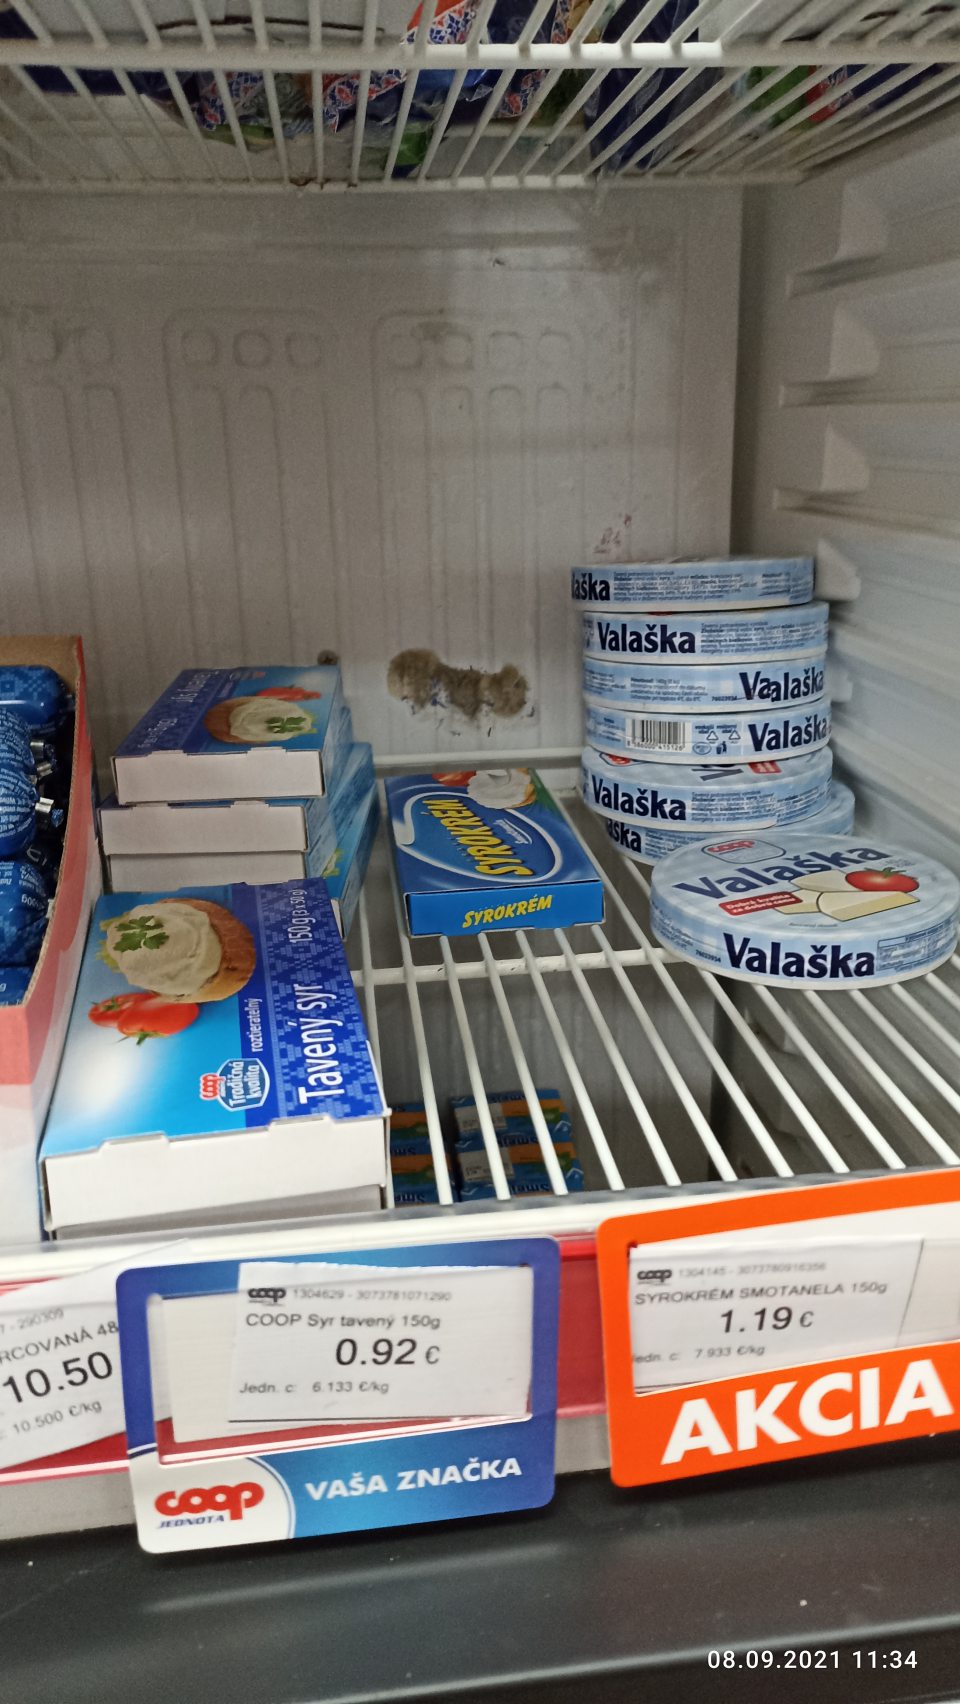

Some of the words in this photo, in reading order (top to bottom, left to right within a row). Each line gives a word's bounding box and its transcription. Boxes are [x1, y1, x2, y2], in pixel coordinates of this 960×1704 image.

[571, 572, 611, 601] laška
[597, 622, 696, 654] Valaška
[748, 714, 828, 752] Valaška
[592, 774, 687, 820] Valaška
[421, 798, 534, 876] SYROKRÉM
[671, 846, 892, 900] Valaška
[461, 893, 554, 929] SYROKRÉM
[722, 932, 875, 979] Valaška
[293, 983, 338, 1012] syr
[288, 1017, 345, 1105] Tavený
[634, 1287, 735, 1306] SYROKRÉM
[739, 1281, 844, 1300] SMOTANELA
[851, 1280, 888, 1296] 150g
[246, 1313, 302, 1328] COOP
[307, 1313, 335, 1330] Syr
[340, 1313, 395, 1330] tavený
[402, 1315, 441, 1331] 150g
[720, 1305, 794, 1334] 1.19
[799, 1310, 815, 1329] €
[0, 1325, 94, 1364] RCOVANÁ
[97, 1320, 119, 1337] 48
[335, 1338, 417, 1366] 0.92
[425, 1345, 441, 1365] €
[3, 1351, 113, 1404] 10.50
[358, 1381, 390, 1396] €/kg
[660, 1358, 955, 1466] AKCIA
[305, 1472, 389, 1501] VAŠA
[396, 1457, 523, 1491] ZNAČKA
[155, 1481, 265, 1521] coop
[157, 1514, 225, 1530] JEDNOTA
